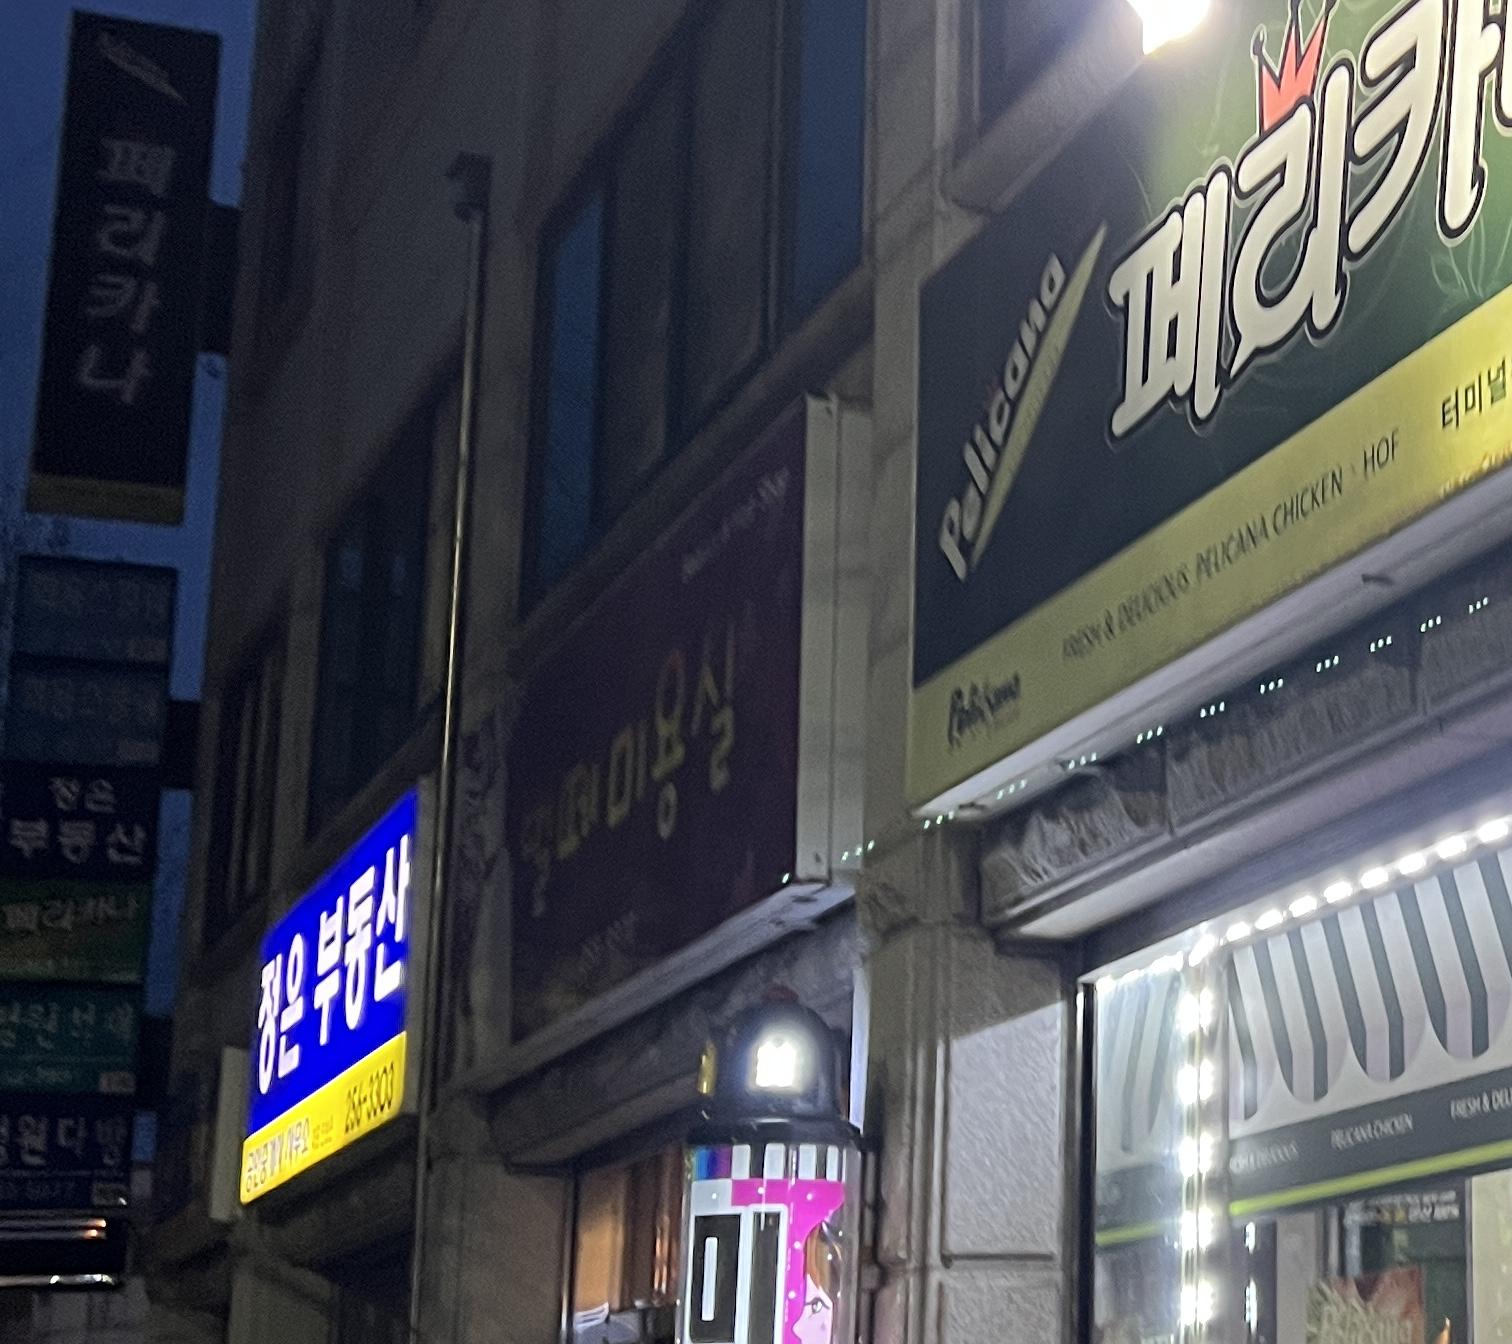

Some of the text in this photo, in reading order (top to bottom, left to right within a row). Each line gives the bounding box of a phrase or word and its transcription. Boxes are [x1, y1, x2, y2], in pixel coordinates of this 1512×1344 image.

[79, 138, 178, 405] 페리카나
[1271, 464, 1344, 536] CHICKEN
[1362, 429, 1400, 482] HOF
[258, 833, 411, 1095] 정은 부동산
